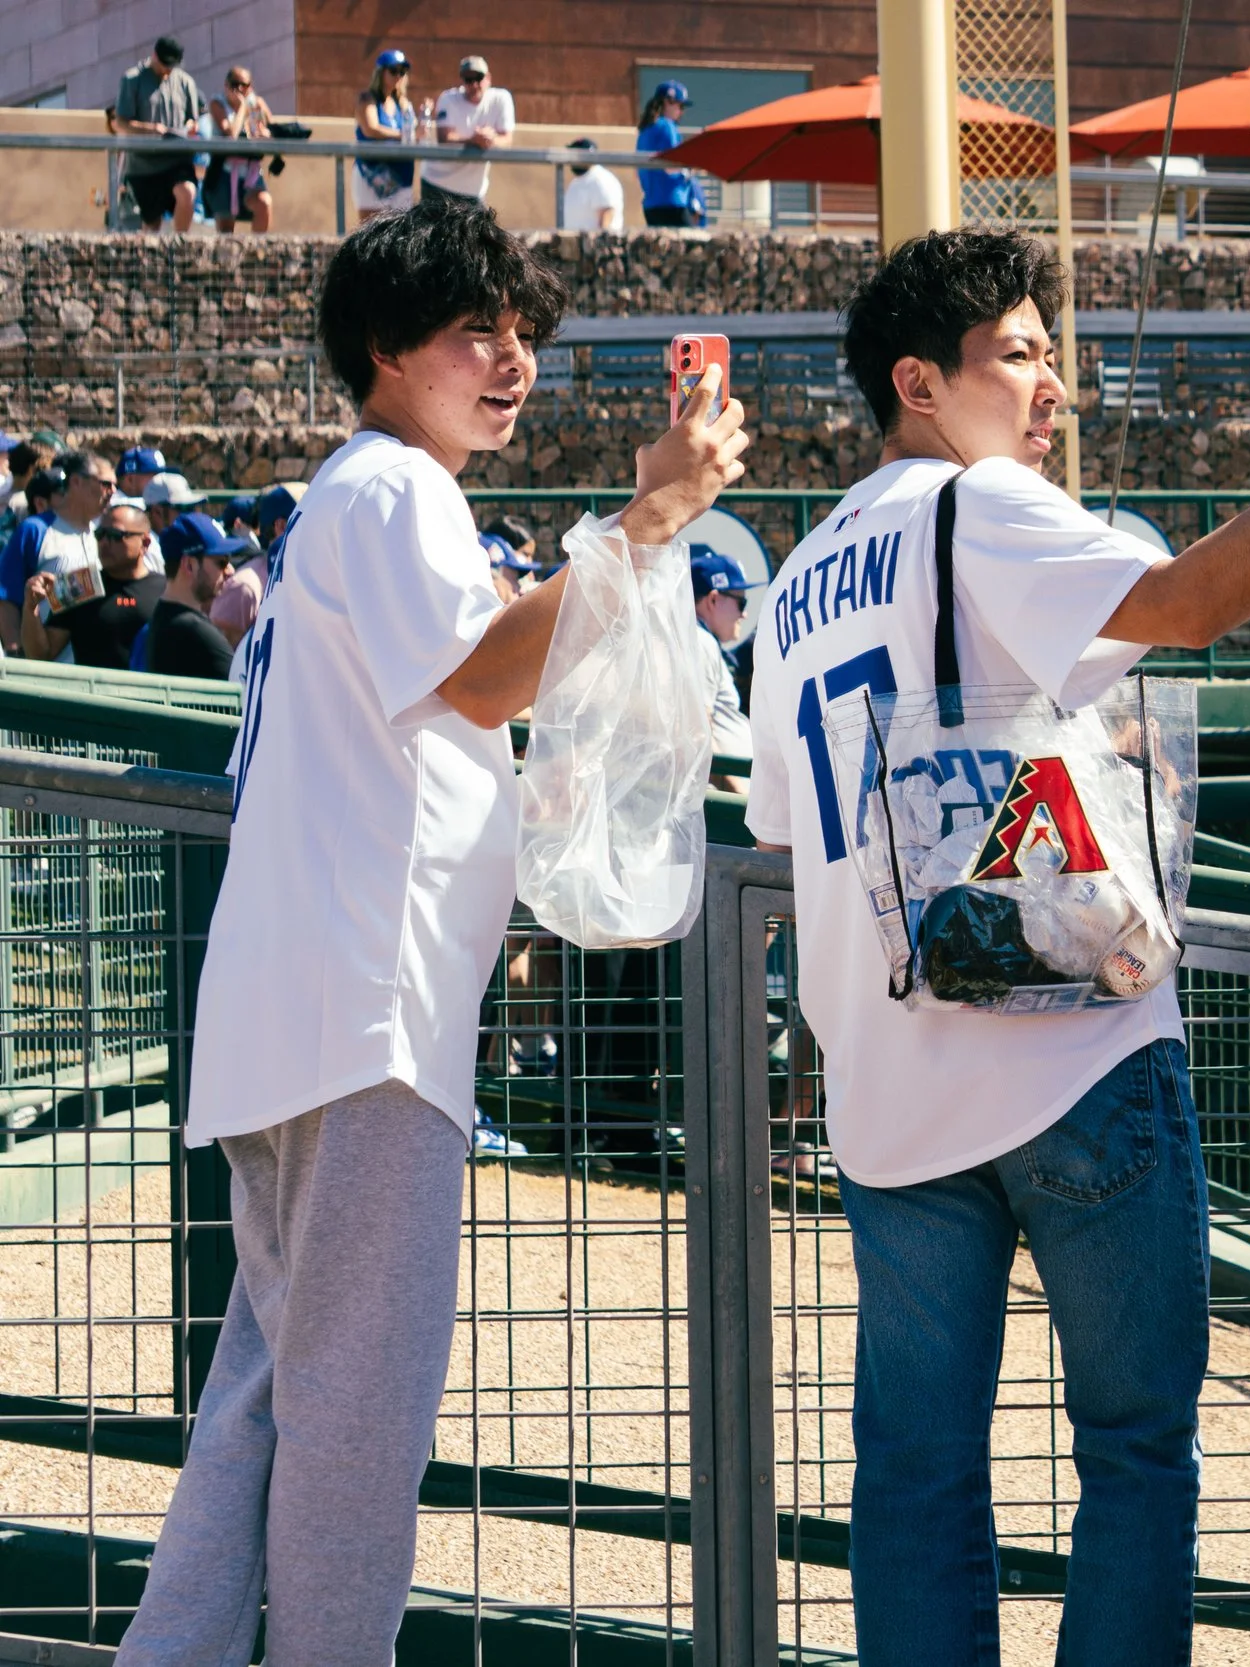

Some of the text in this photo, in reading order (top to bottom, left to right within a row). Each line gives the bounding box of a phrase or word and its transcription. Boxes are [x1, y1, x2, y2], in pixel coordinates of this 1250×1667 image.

[775, 531, 903, 661] OHTANI
[797, 645, 898, 863] 17
[1112, 954, 1141, 980] CACTUS
[1117, 947, 1146, 973] LEAGUE
